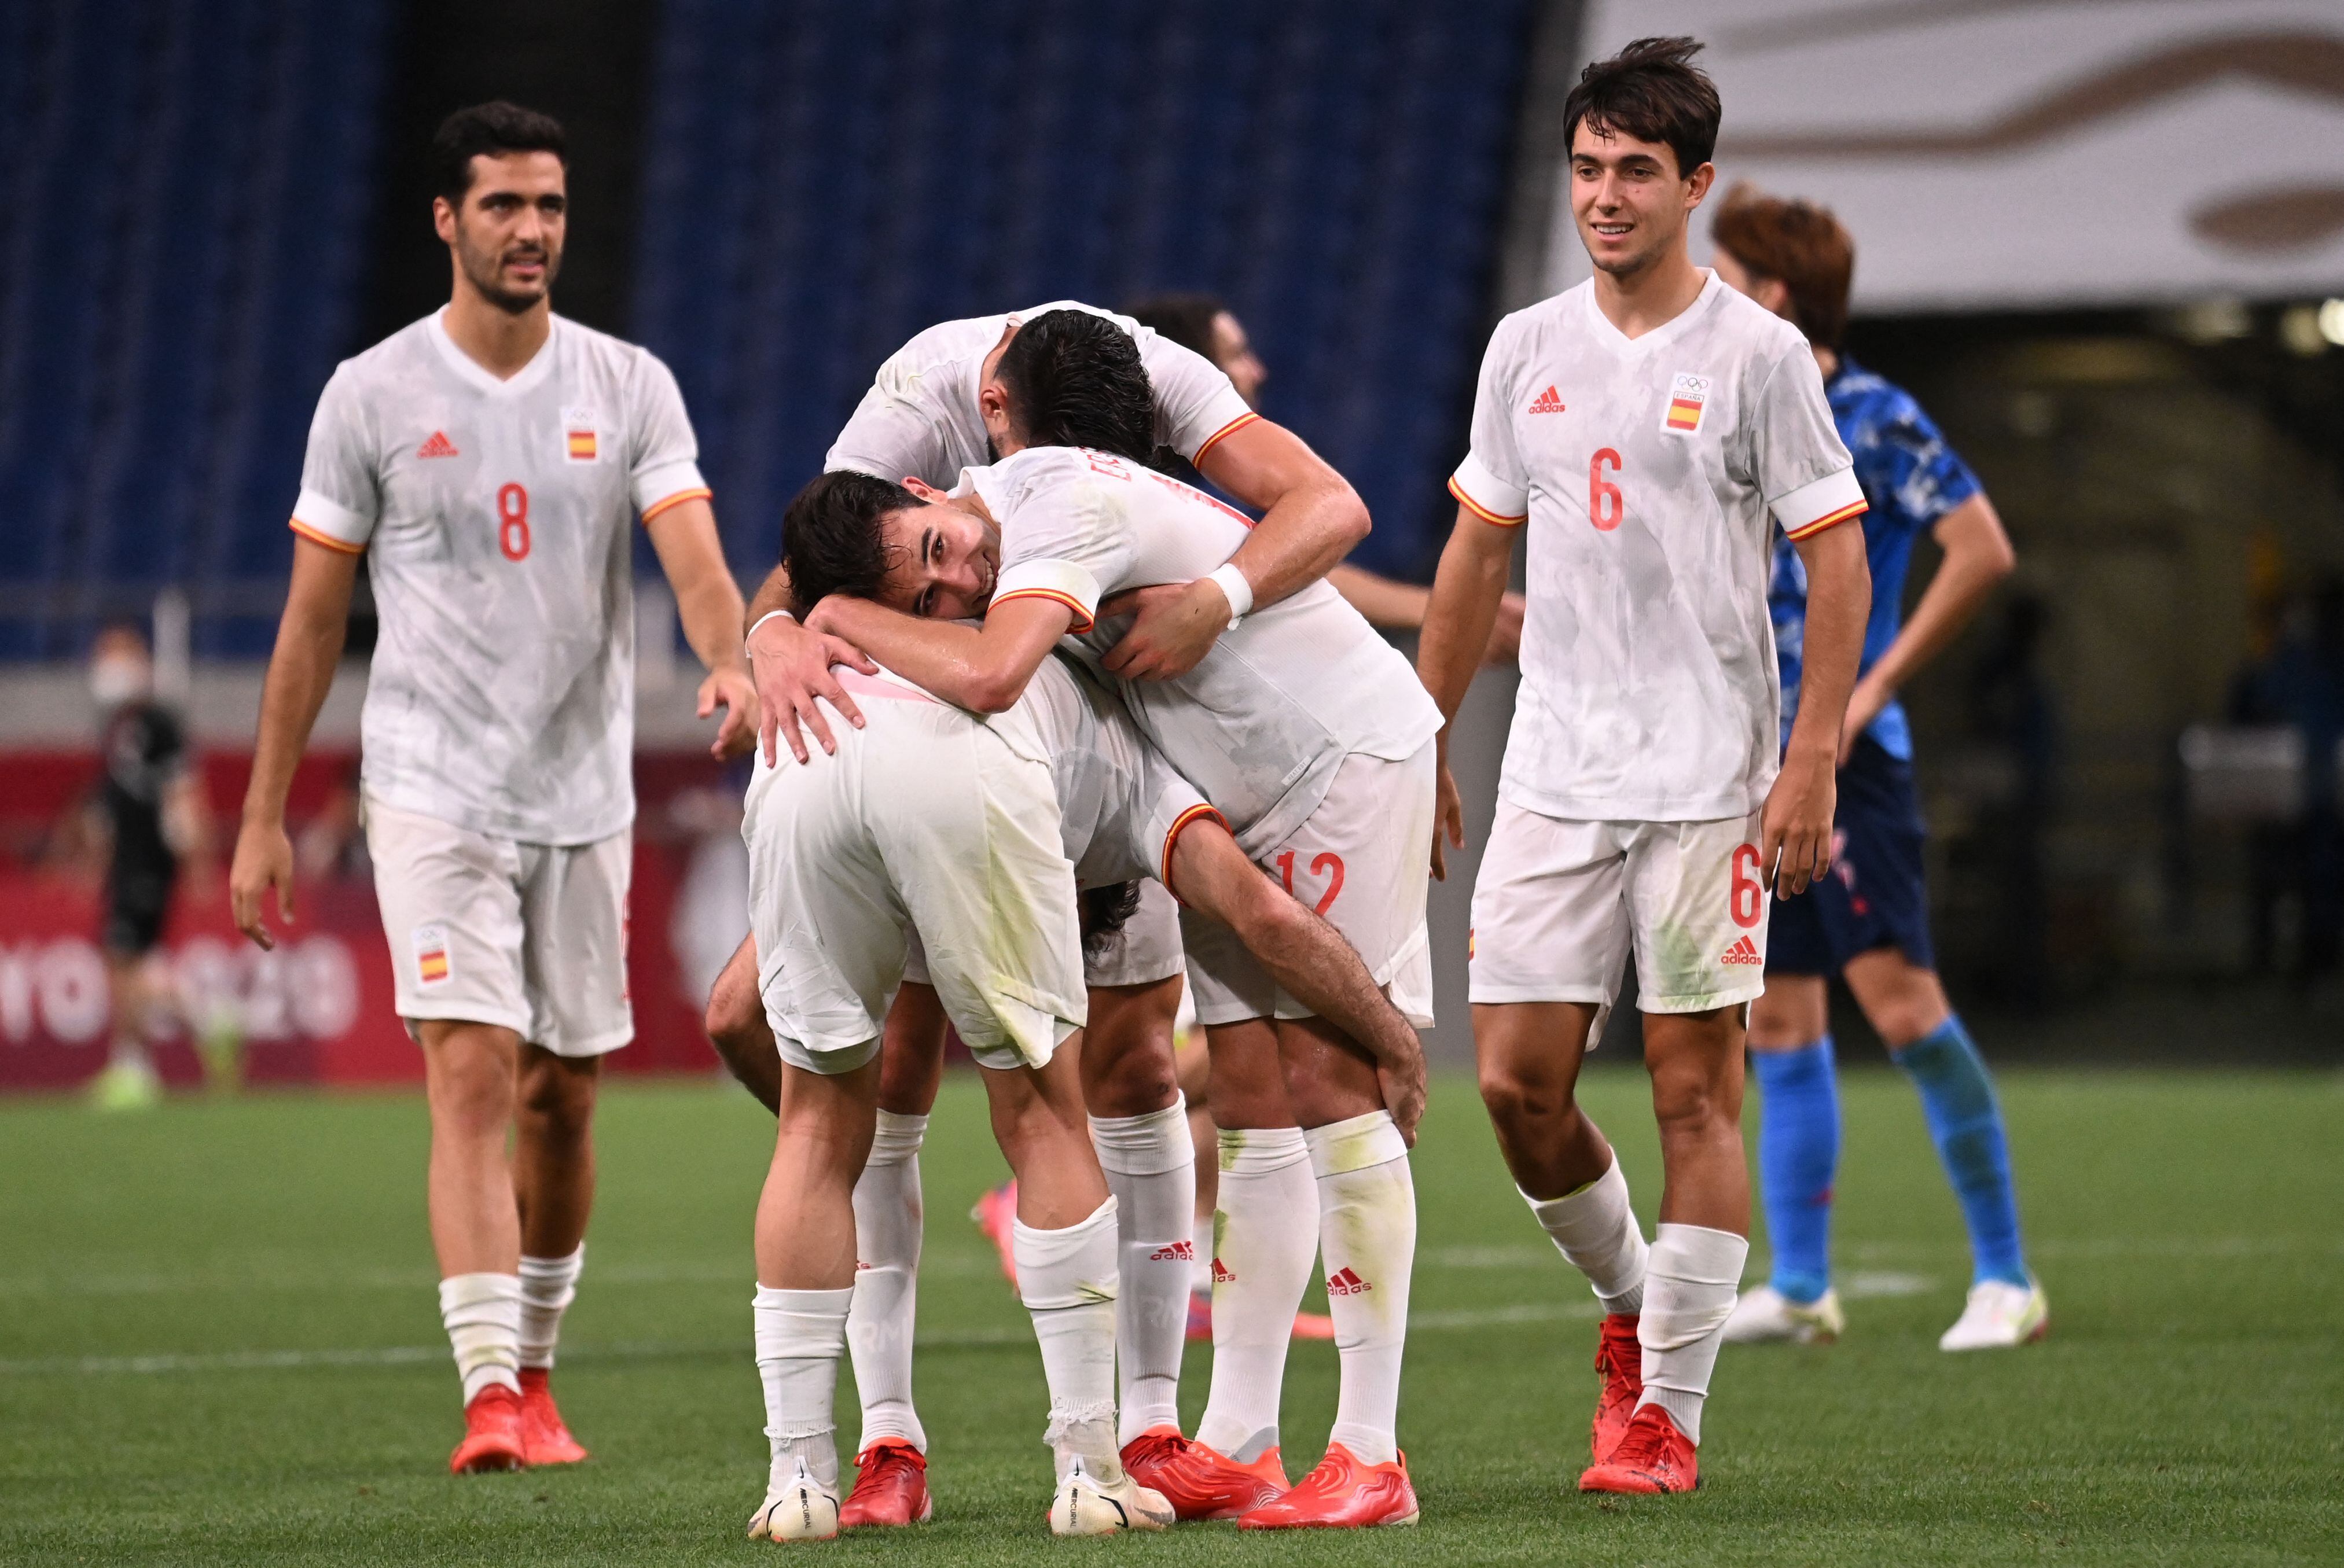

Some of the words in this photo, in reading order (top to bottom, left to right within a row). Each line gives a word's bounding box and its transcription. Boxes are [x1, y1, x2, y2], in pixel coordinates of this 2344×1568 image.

[1529, 403, 1565, 414] adidas
[1676, 393, 1700, 401] ESPAÑA
[1589, 447, 1623, 531] 6
[497, 481, 531, 562] 8
[1276, 851, 1345, 916] 12
[1730, 843, 1761, 928] 6
[1721, 954, 1762, 965] adidas
[800, 1488, 811, 1530] MERCURIAL
[1070, 1488, 1078, 1528] MERCURIAL
